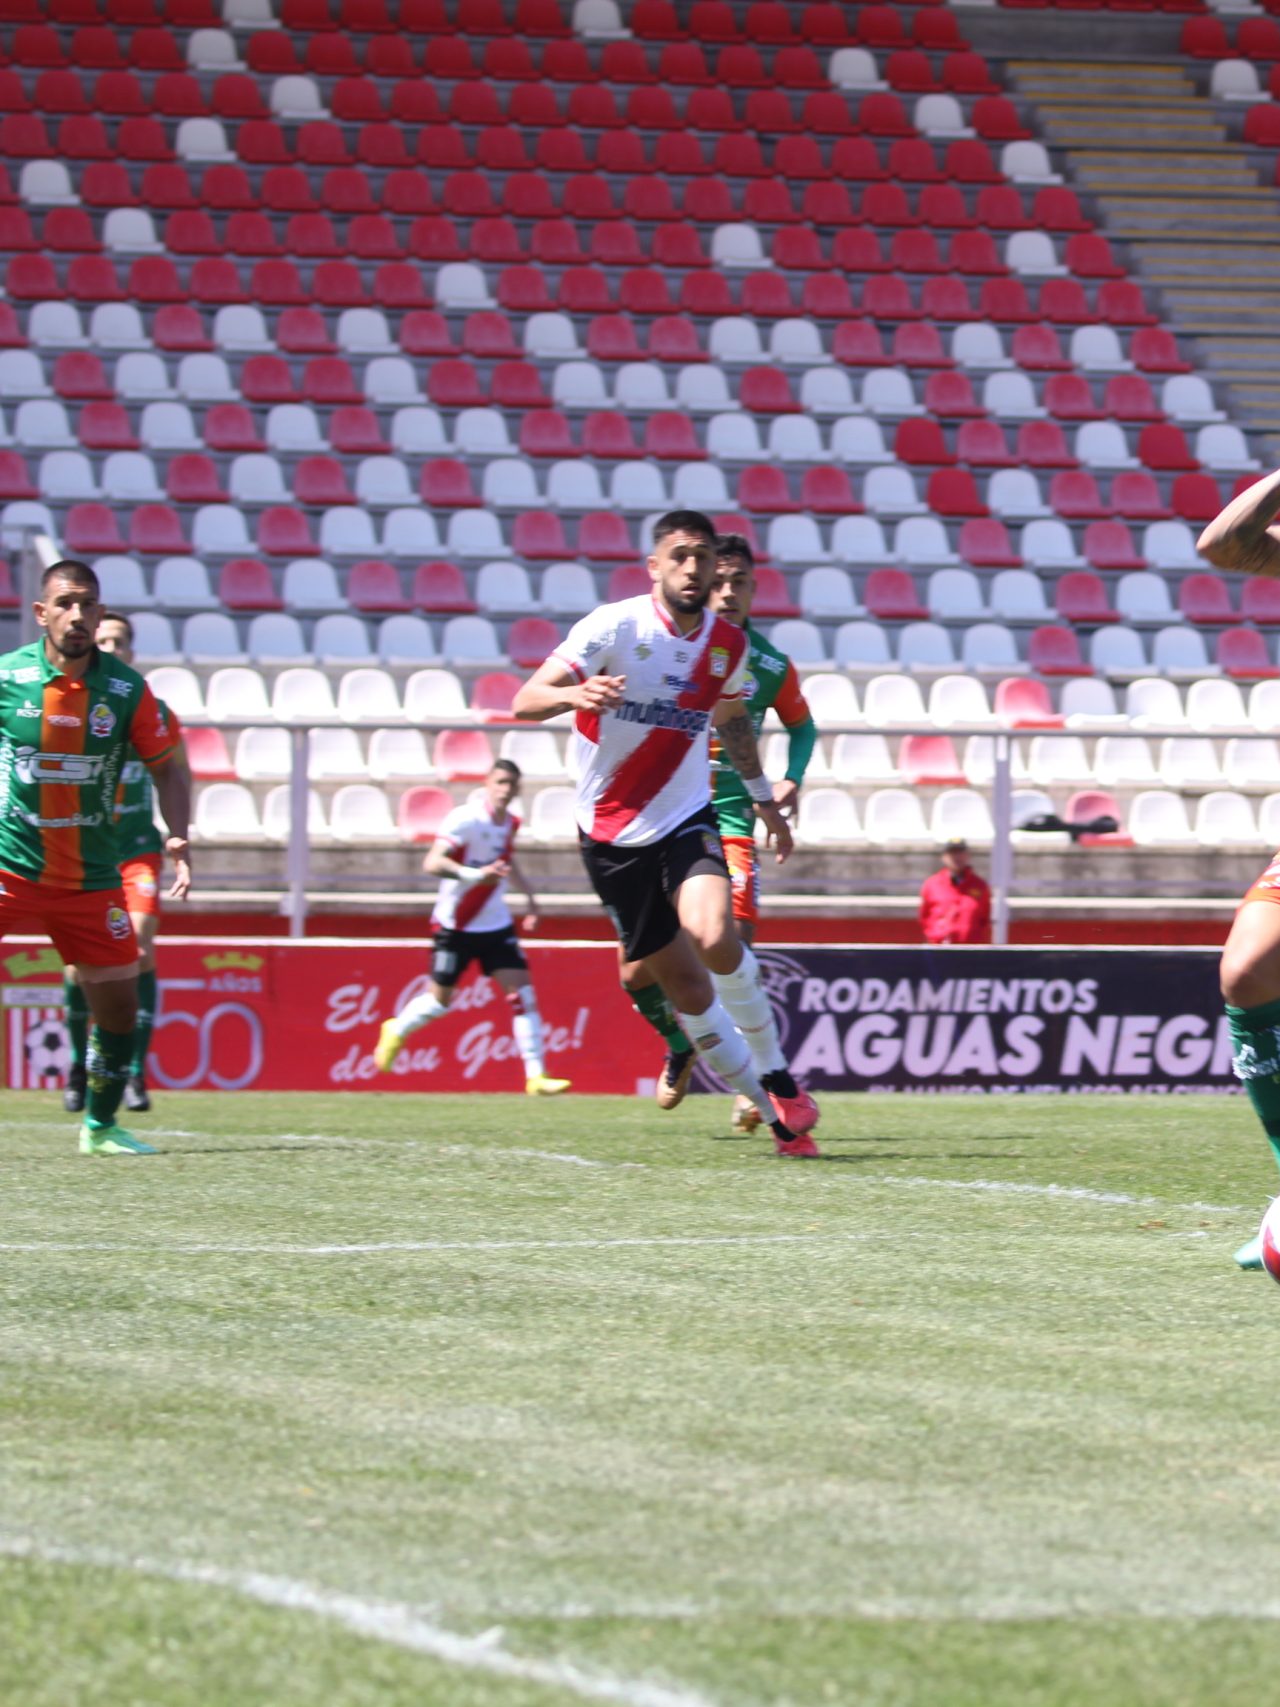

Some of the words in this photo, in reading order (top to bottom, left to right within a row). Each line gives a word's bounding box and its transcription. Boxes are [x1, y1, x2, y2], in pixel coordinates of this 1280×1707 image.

[209, 972, 262, 992] AÑOS
[799, 977, 1097, 1013] RODAMIENTOS
[325, 984, 380, 1032] El
[147, 978, 263, 1089] 50
[788, 1013, 1046, 1077] AGUAS
